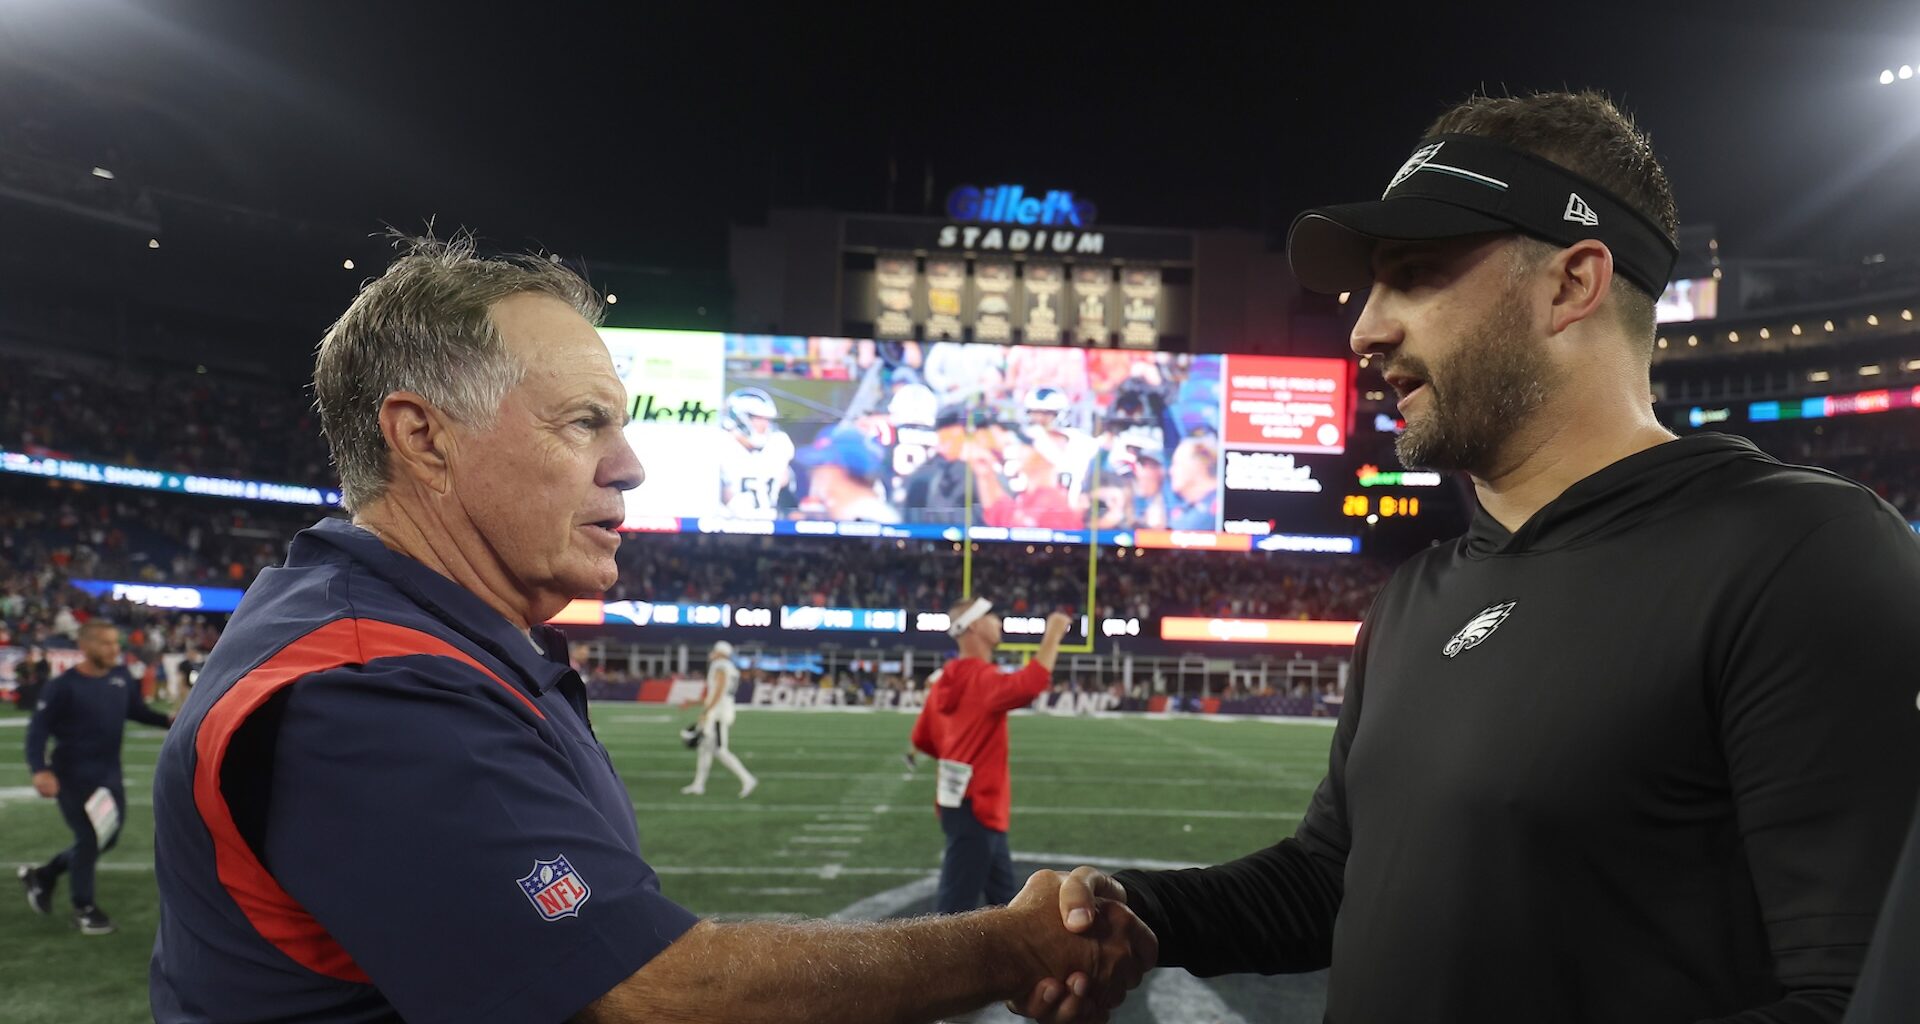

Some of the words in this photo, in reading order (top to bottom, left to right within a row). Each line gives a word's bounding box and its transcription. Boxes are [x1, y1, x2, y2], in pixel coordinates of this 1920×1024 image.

[948, 185, 1097, 227] Gillette
[938, 226, 1104, 253] STADIUM
[629, 395, 718, 423] llette
[741, 477, 778, 509] 51
[537, 877, 585, 914] NFL
